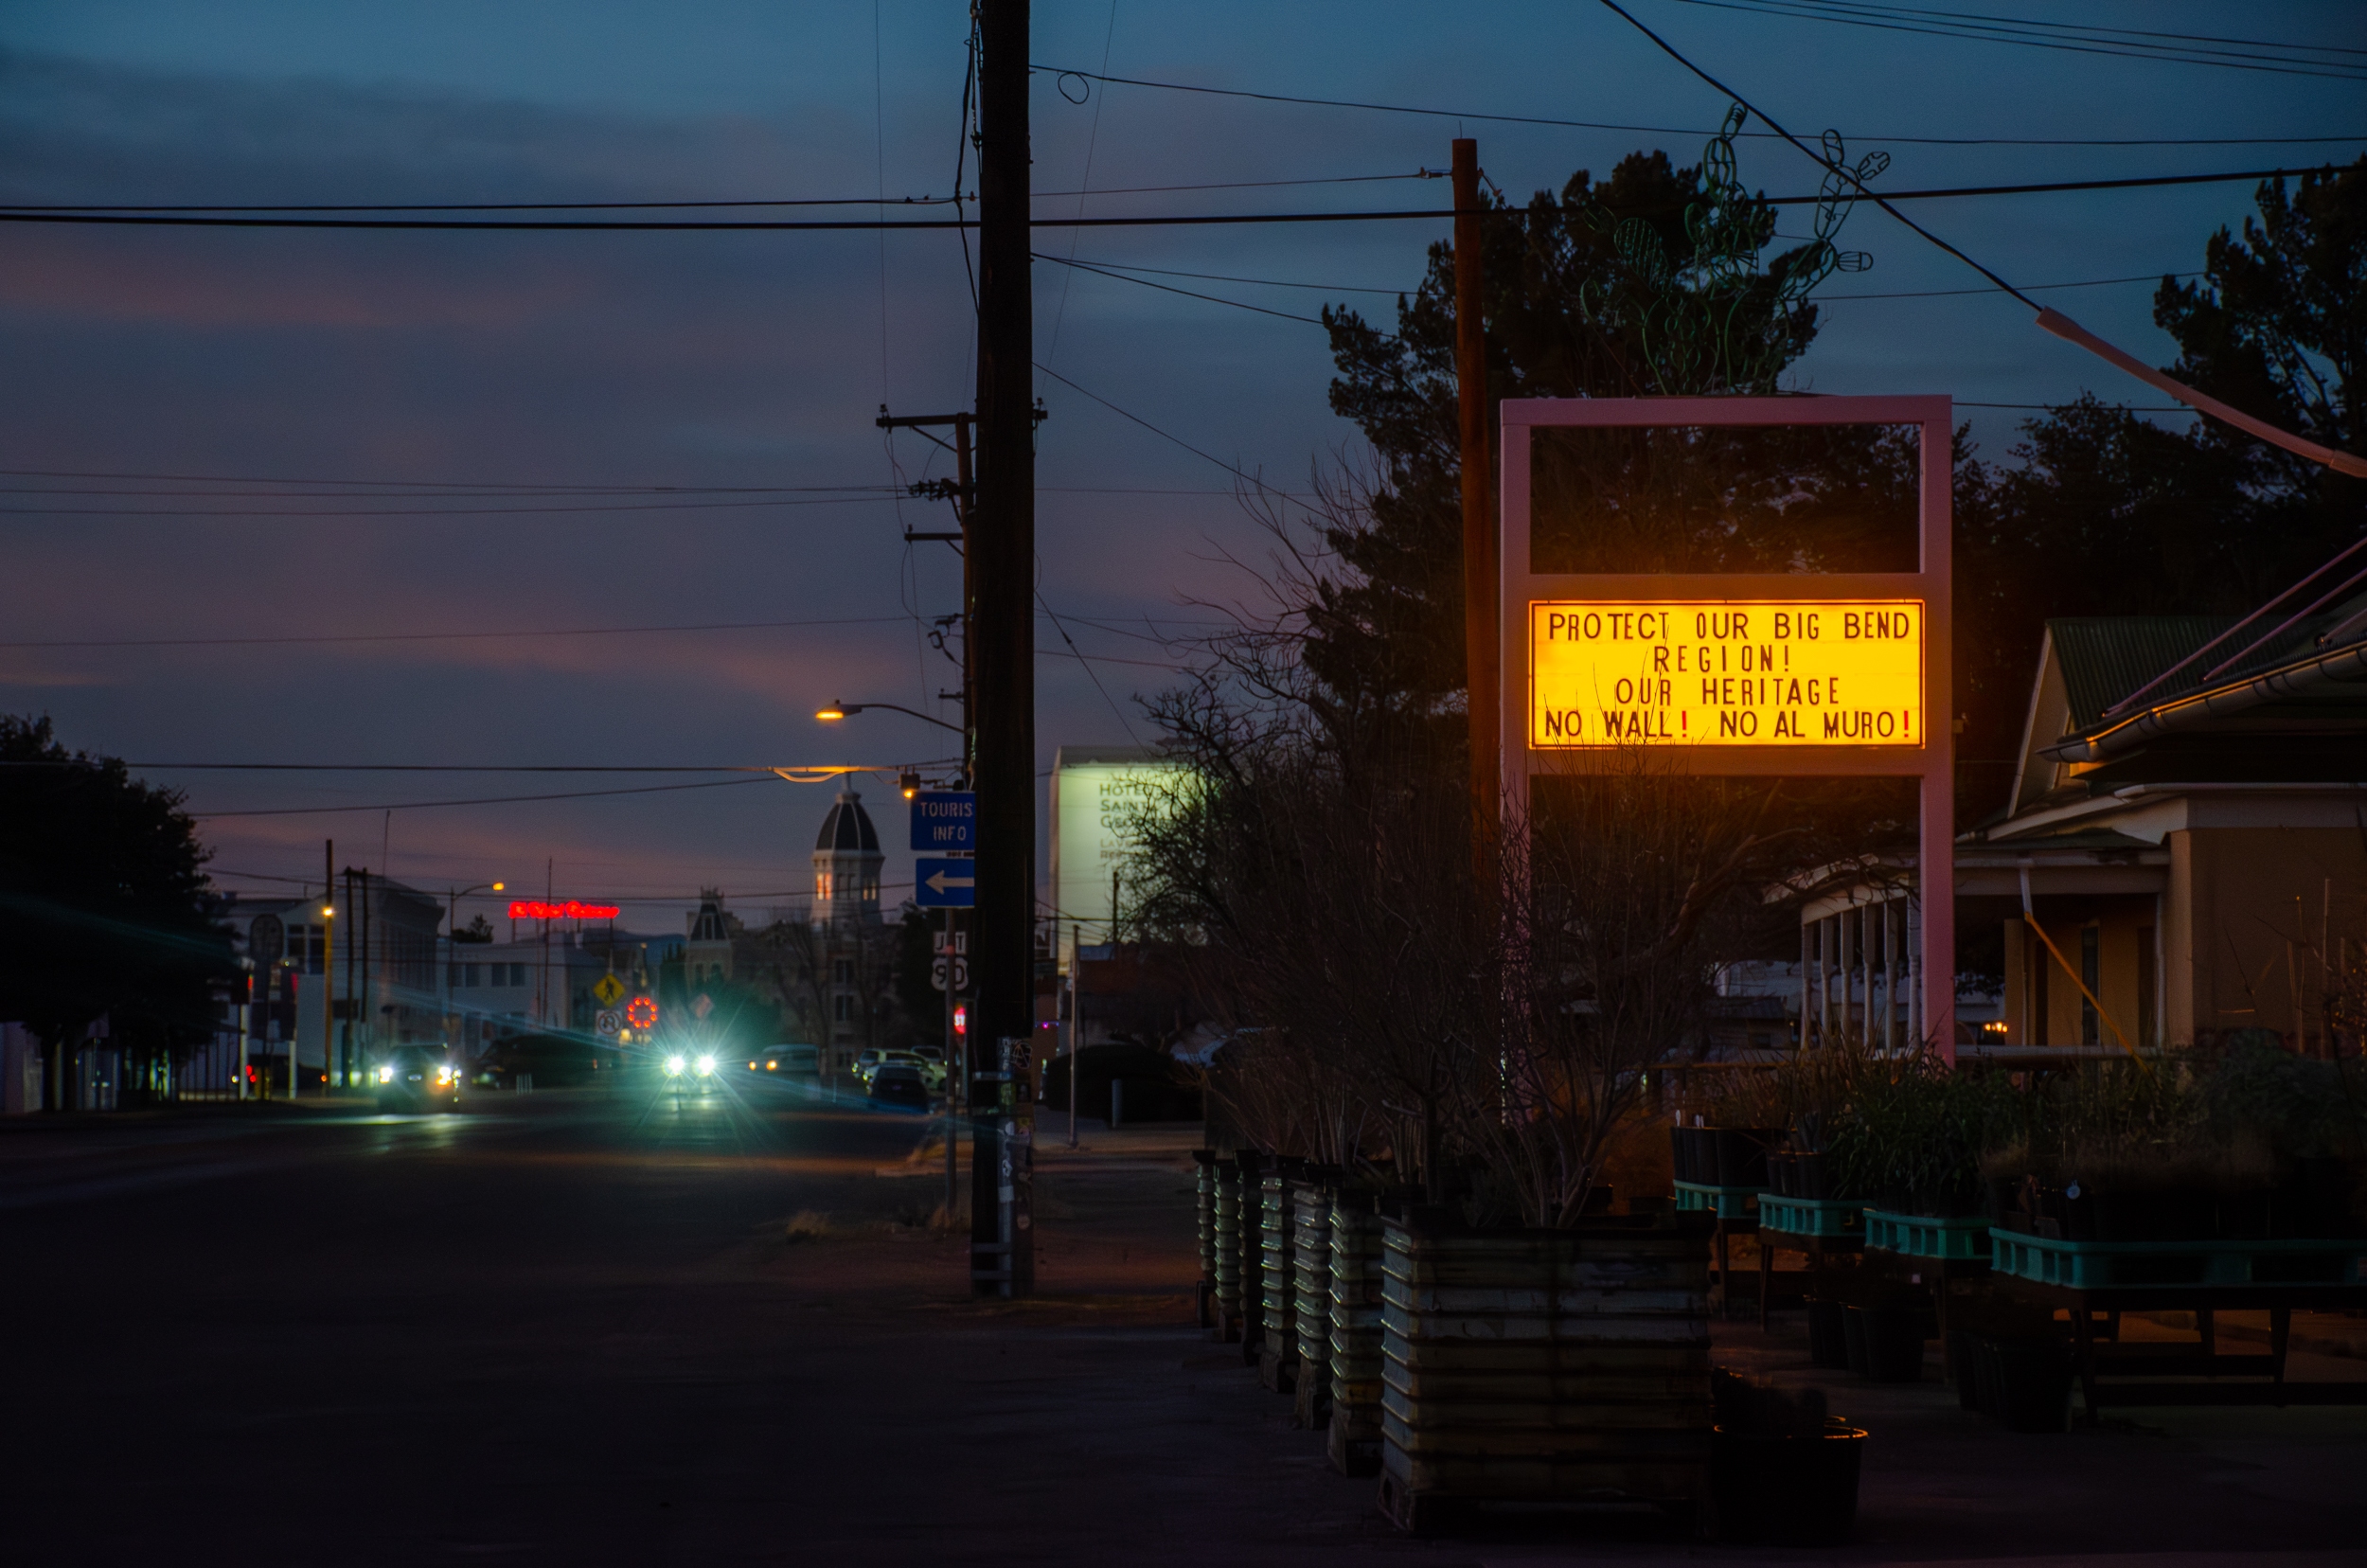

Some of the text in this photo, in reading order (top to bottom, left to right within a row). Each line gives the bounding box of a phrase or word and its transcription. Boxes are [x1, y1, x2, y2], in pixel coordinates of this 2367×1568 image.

[1549, 611, 1910, 641] PROTECT OUR BIG BEND
[1615, 677, 1839, 706] OUR HERITAGE
[1545, 710, 1909, 739] NO WALL! NO AL MURO!
[920, 801, 973, 817] TOURIS
[933, 825, 967, 842] INFO
[935, 934, 964, 951] JT
[934, 964, 965, 986] 90
